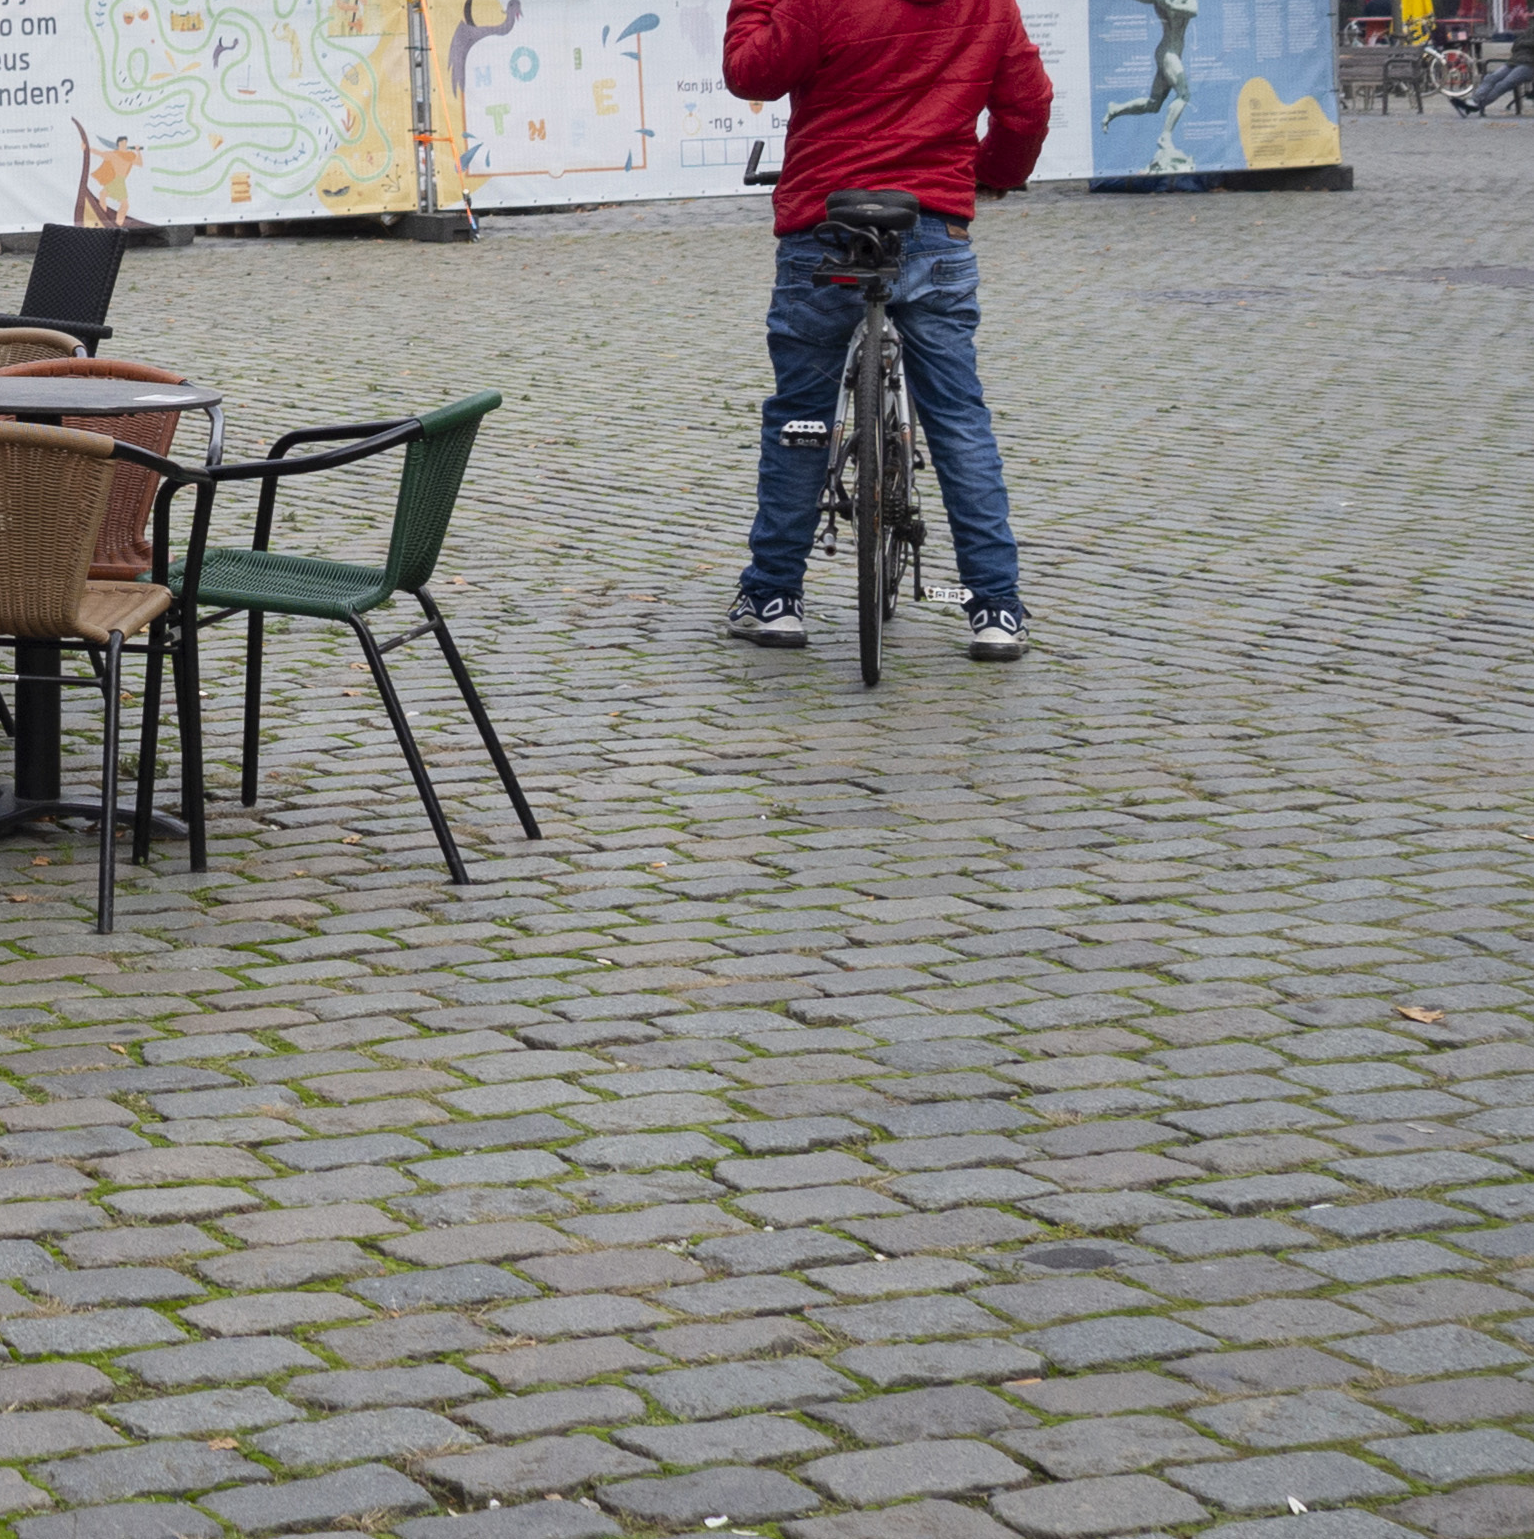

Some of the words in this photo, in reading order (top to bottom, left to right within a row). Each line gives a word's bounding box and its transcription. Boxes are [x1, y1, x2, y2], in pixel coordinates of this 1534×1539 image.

[21, 16, 56, 36] om
[677, 80, 698, 92] Kan
[701, 78, 712, 93] jij
